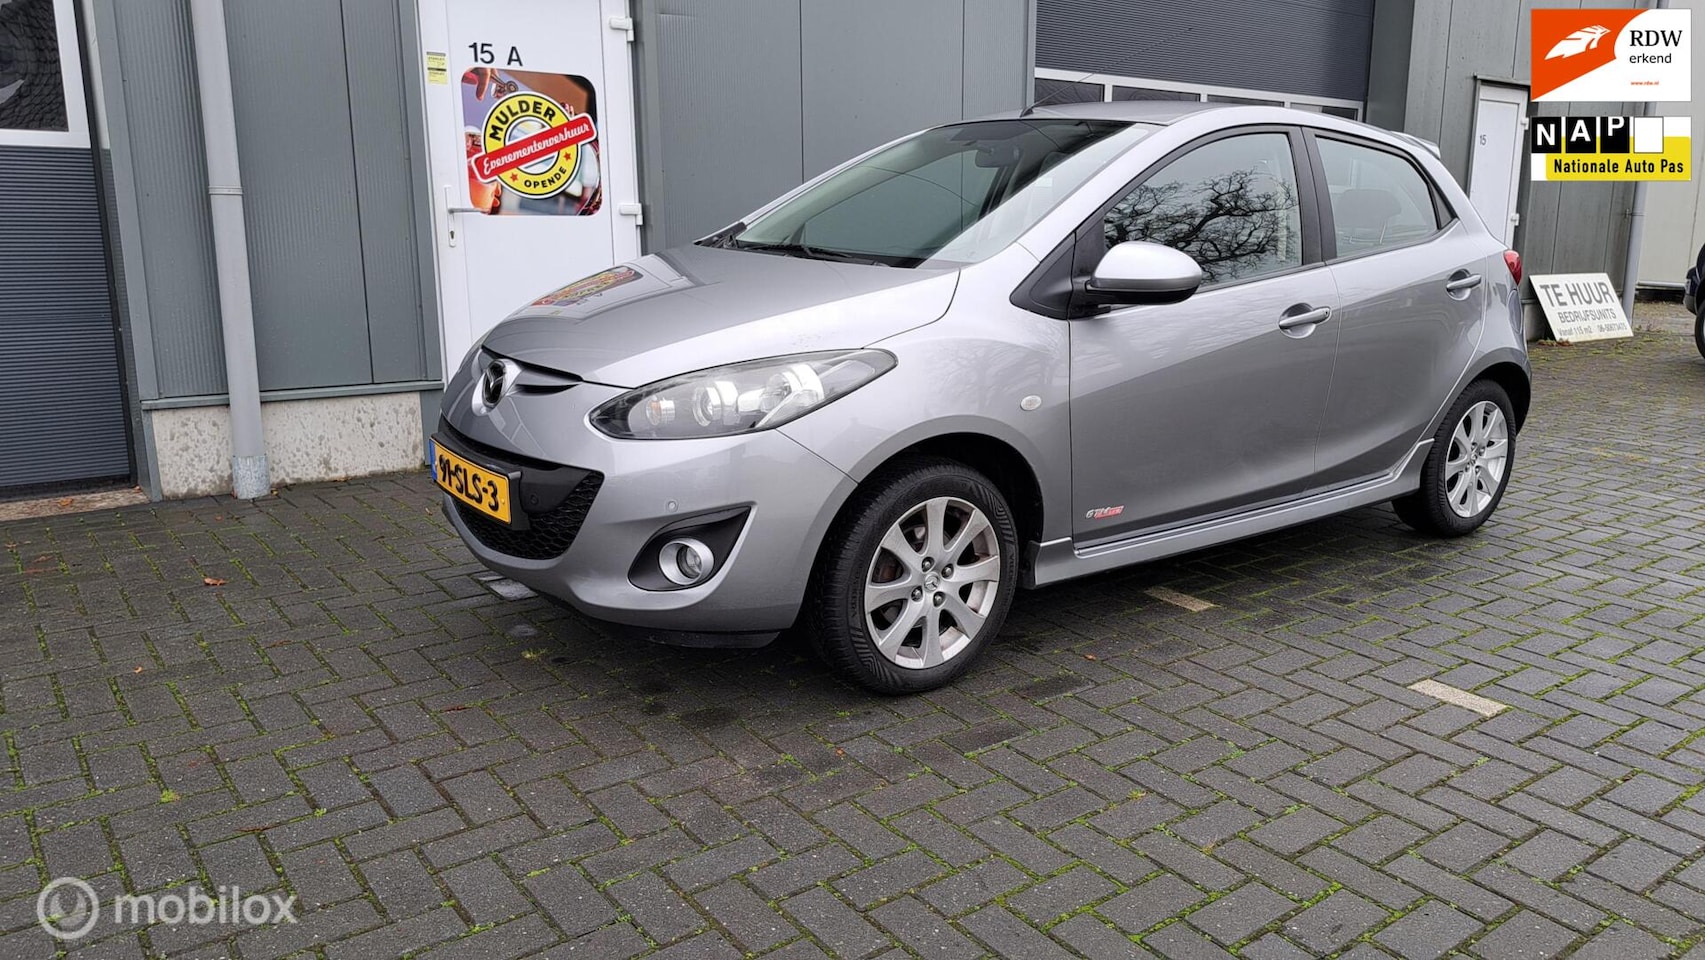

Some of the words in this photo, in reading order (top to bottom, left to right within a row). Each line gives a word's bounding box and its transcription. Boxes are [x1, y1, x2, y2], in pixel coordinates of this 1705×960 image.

[468, 42, 495, 65] 15
[506, 46, 524, 67] A
[489, 100, 556, 141] MULDER
[482, 121, 590, 175] Evenementenverhuur
[1479, 135, 1487, 146] 15
[523, 166, 567, 189] OPENDE
[1539, 283, 1568, 307] TE
[1565, 282, 1615, 305] HUUR
[1557, 308, 1617, 323] BEDRIJFSUNITS
[438, 454, 499, 512] 91-SLS-3
